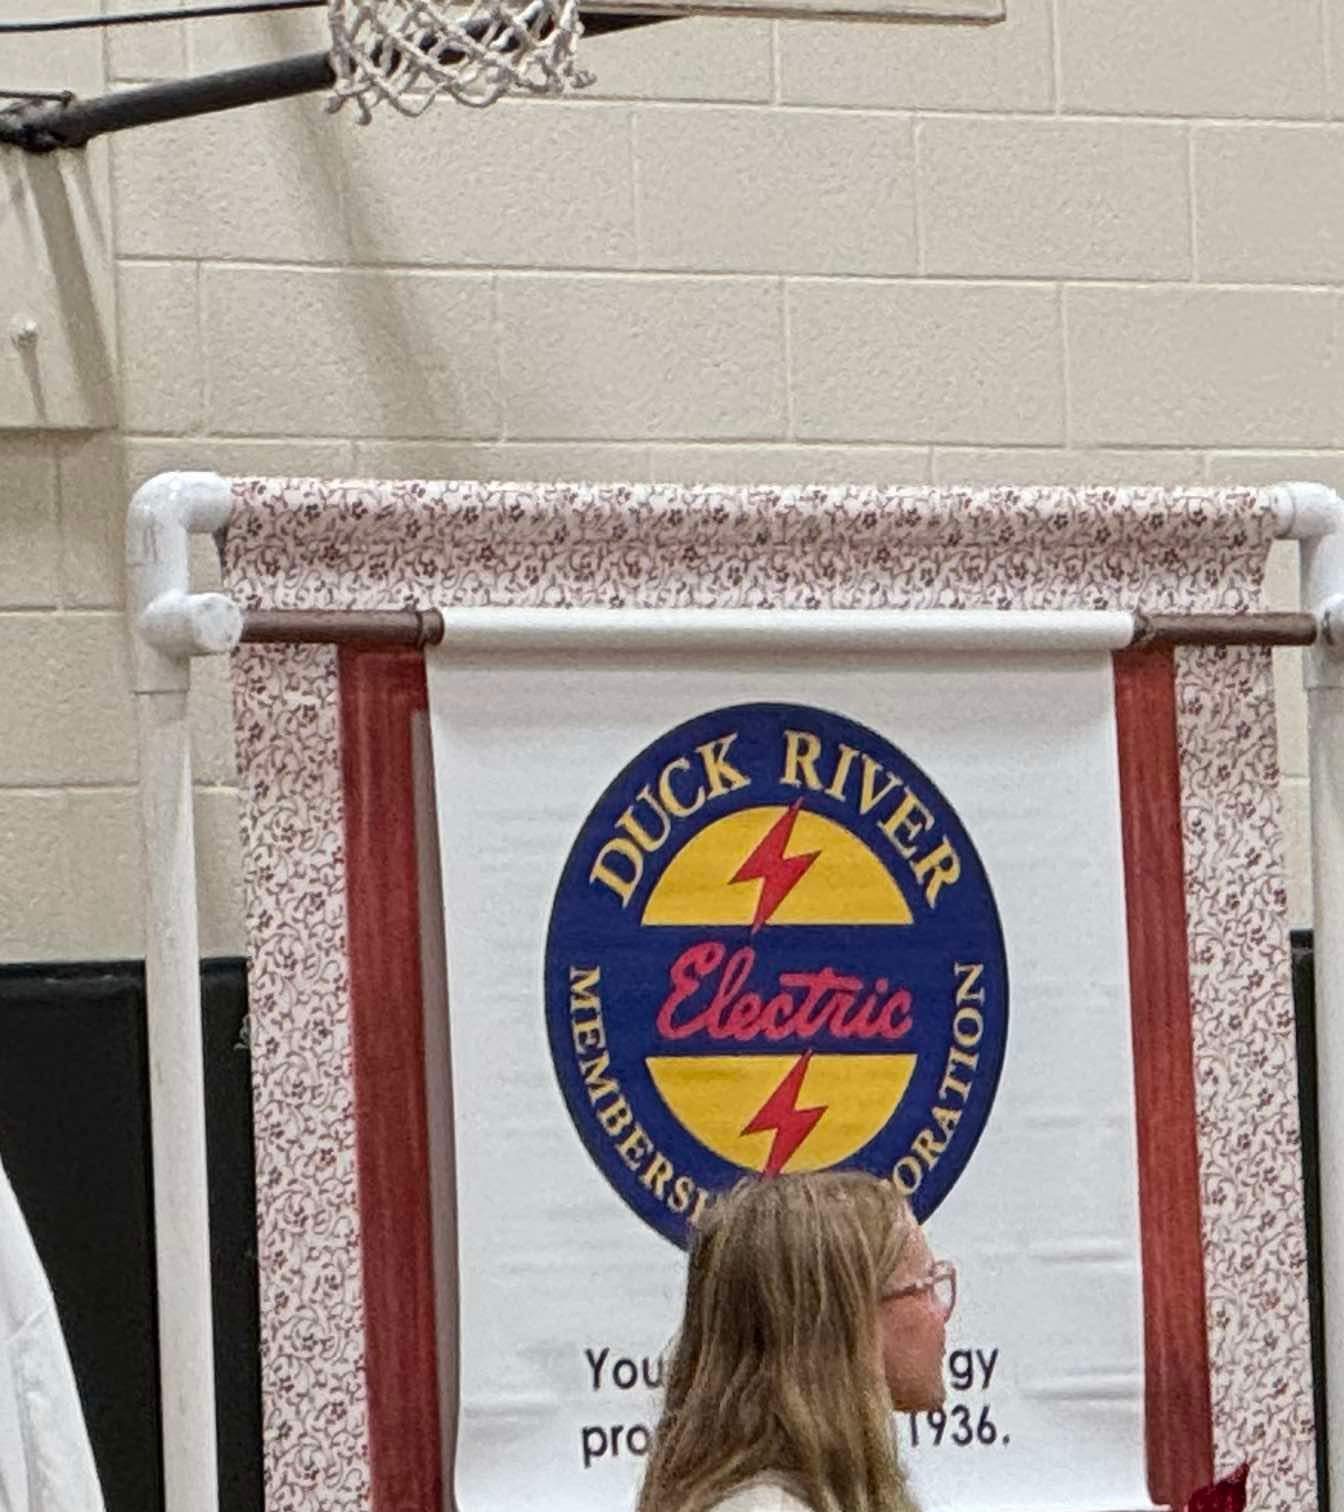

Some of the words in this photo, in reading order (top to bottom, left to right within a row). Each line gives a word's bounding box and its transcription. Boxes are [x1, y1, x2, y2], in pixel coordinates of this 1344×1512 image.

[589, 732, 751, 908] DUCK
[779, 729, 961, 908] RIVER
[656, 940, 914, 1041] Electric
[910, 1404, 1011, 1447] 1936.
